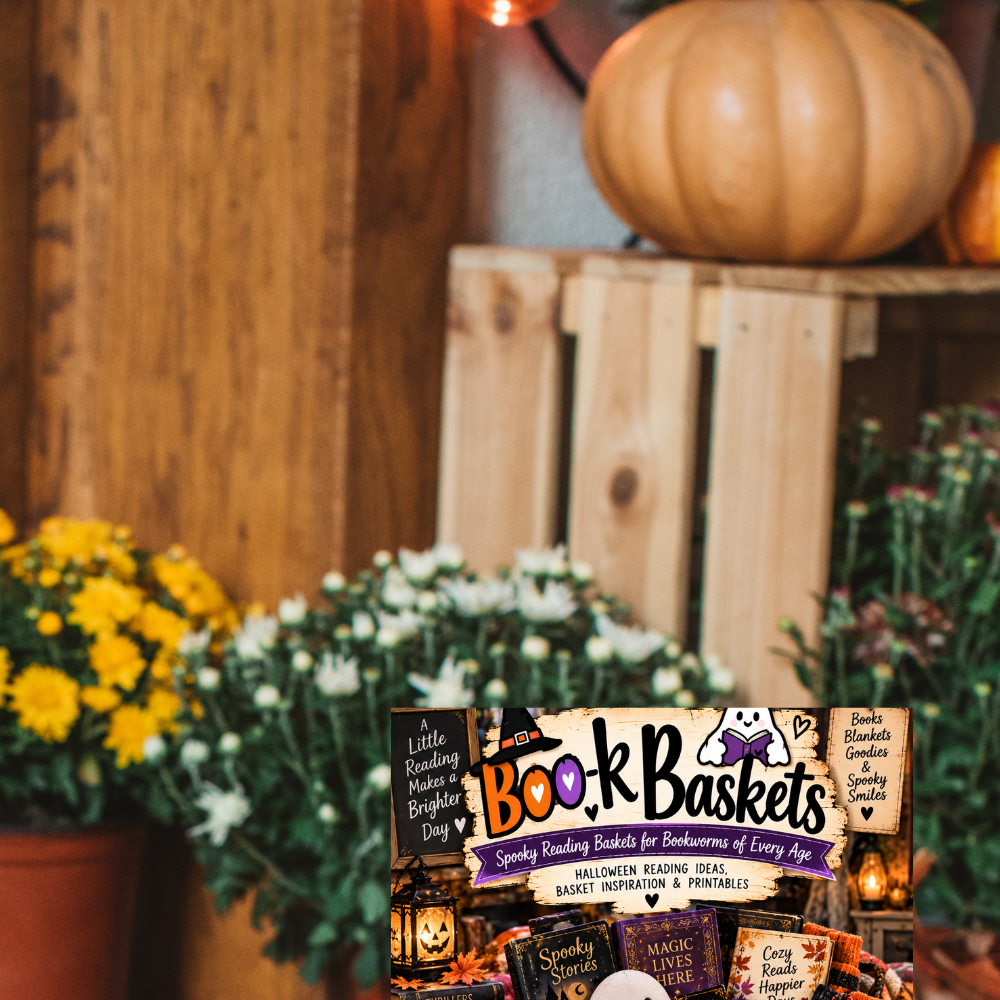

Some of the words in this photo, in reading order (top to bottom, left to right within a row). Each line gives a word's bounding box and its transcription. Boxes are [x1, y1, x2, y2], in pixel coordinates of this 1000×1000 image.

[421, 719, 428, 731] A
[409, 730, 447, 755] Little
[405, 751, 460, 776] Reading
[409, 774, 445, 795] Makes
[450, 773, 458, 782] a
[408, 792, 462, 819] Brighter
[422, 823, 450, 842] Day
[538, 936, 595, 970] Spooky
[550, 960, 598, 986] Stories
